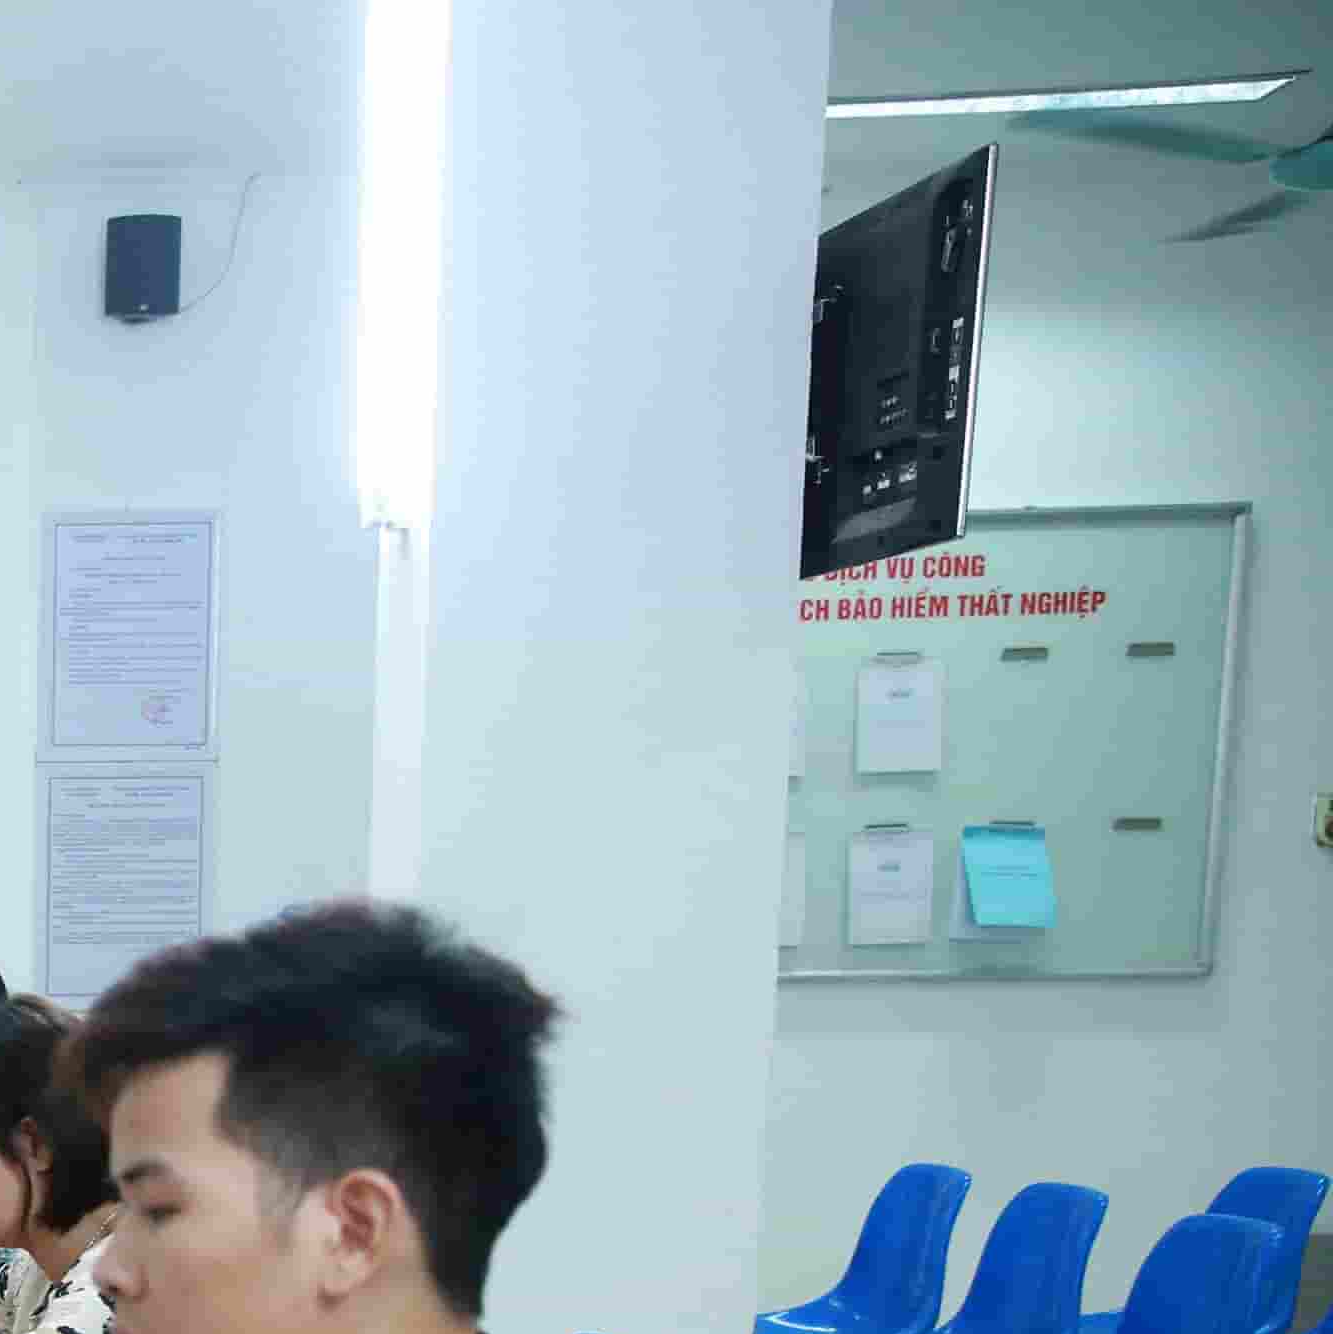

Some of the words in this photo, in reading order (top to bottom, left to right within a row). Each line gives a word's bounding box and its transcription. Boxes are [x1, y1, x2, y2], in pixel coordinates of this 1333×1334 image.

[885, 556, 915, 585] VỤ
[922, 551, 987, 578] CÔNG
[837, 588, 883, 621] BẢO
[957, 584, 1013, 617] THẤT
[1020, 584, 1107, 620] NGHIỆP
